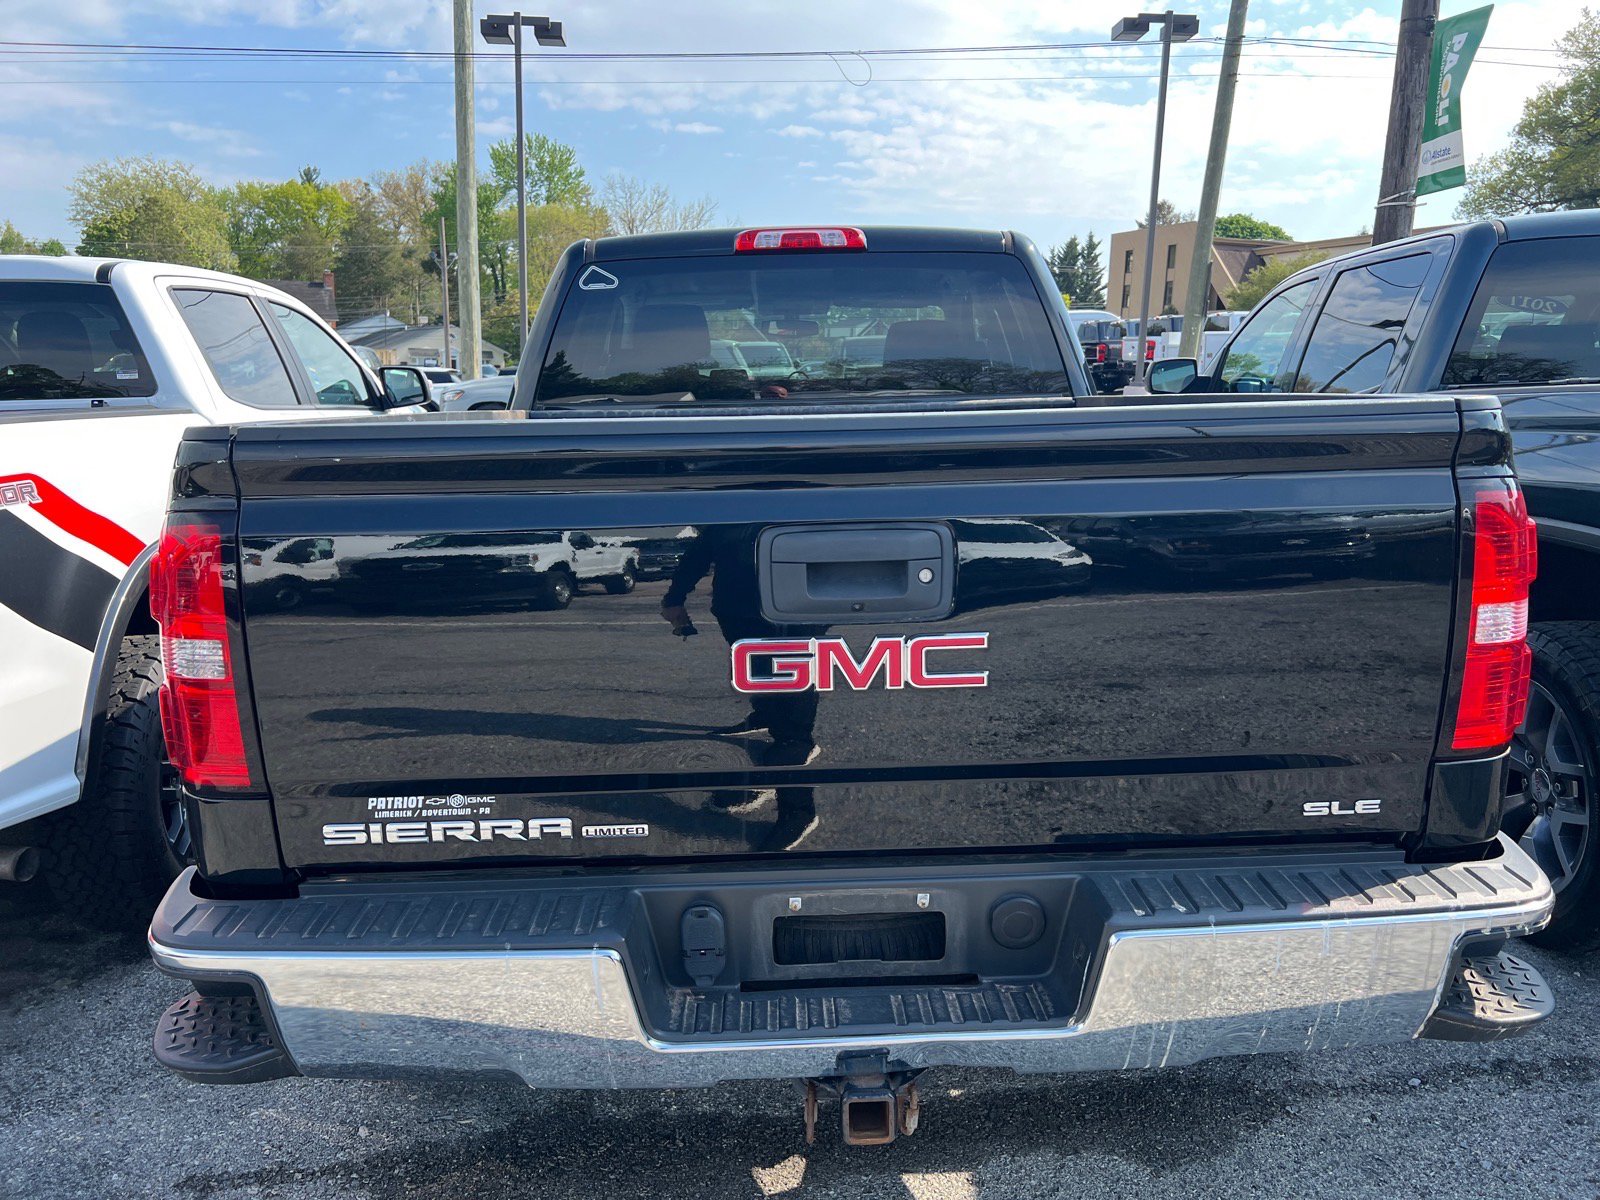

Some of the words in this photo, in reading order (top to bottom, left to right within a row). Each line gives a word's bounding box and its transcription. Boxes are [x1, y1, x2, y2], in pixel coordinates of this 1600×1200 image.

[1438, 32, 1469, 127] PAOLI
[1431, 147, 1452, 160] Allstate
[0, 480, 42, 506] OR
[731, 632, 989, 693] GMC
[368, 796, 425, 810] PATRIOT
[467, 796, 496, 804] GMC
[374, 809, 412, 818] LIMERICK
[421, 807, 472, 817] BOYERTOWN
[479, 807, 491, 815] PA
[1302, 799, 1382, 816] SLE
[322, 817, 574, 846] SIERRA
[584, 825, 648, 838] LIMITED
